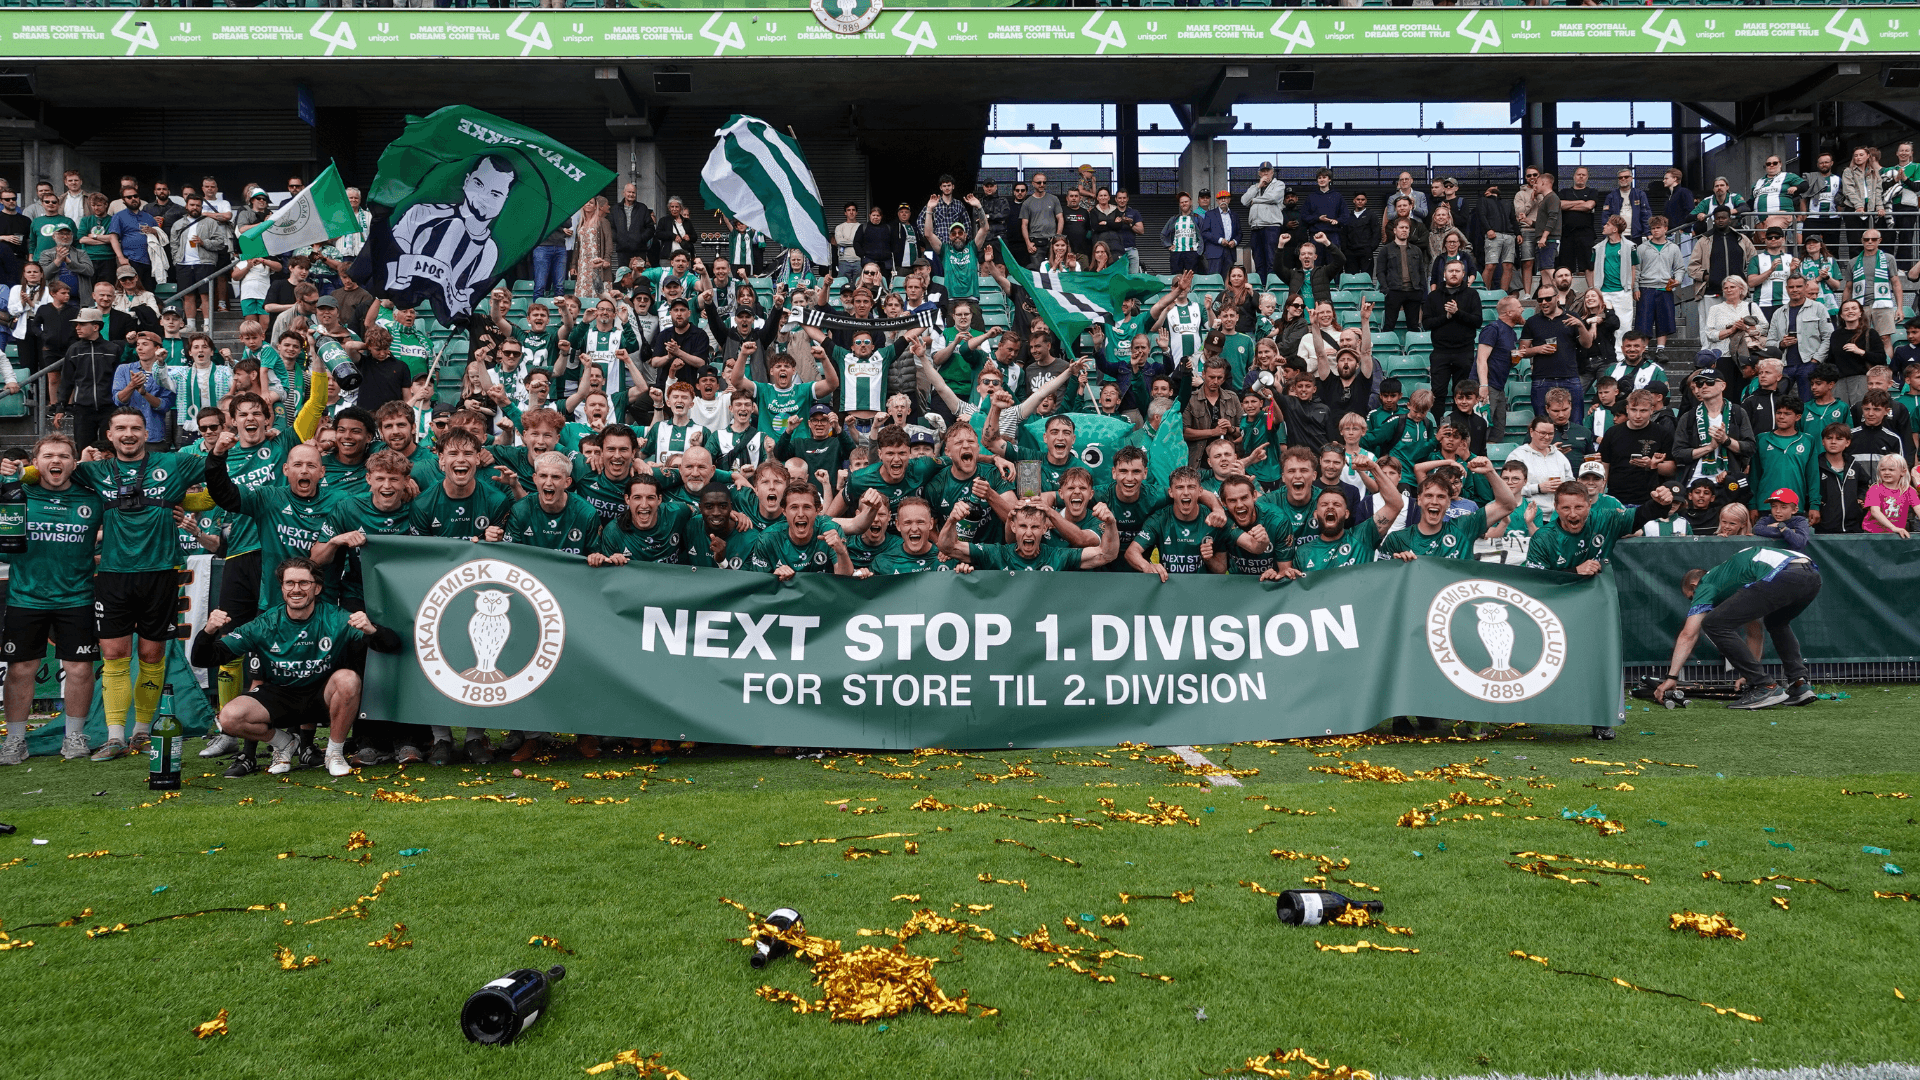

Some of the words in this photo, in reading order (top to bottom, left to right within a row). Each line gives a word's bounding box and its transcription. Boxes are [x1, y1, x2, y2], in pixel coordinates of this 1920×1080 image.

[837, 23, 860, 32] 1889
[170, 34, 201, 43] unisport
[368, 34, 399, 43] unisport
[563, 35, 593, 43] unisport
[757, 34, 787, 43] unisport
[948, 34, 978, 42] unisport
[1138, 33, 1167, 41] unisport
[1325, 33, 1354, 41] unisport
[1512, 32, 1541, 40] unisport
[1695, 31, 1724, 39] unisport
[1879, 31, 1908, 39] unisport
[826, 316, 872, 326] AKADEMISK
[874, 317, 916, 327] BOLDKLUB
[401, 346, 427, 356] terra
[102, 490, 118, 499] NE
[143, 486, 166, 497] TOP
[586, 496, 616, 511] NEXT
[27, 522, 54, 531] EXT
[55, 524, 89, 533] STOP
[277, 523, 311, 541] NEXT
[30, 532, 85, 543] DIVISION
[1162, 553, 1186, 563] NEXT
[1248, 557, 1274, 566] STOP
[418, 563, 492, 662] AKADEMISK
[505, 569, 561, 670] BOLDKLUB
[1431, 583, 1485, 664] AKADEMISK
[1496, 587, 1563, 667] BOLDKLUB
[642, 607, 819, 661] NEXT
[845, 614, 1011, 661] STOP
[1036, 614, 1076, 660] 1.
[1092, 605, 1359, 660] DIVISION
[76, 645, 91, 654] AK
[270, 660, 303, 670] NEXT
[461, 684, 507, 703] 1889
[743, 673, 821, 705] FOR
[843, 674, 971, 706] STORE
[990, 675, 1046, 705] TIL
[1064, 675, 1095, 706] 2.
[1106, 672, 1266, 705] DIVISION
[1481, 683, 1525, 699] 1889
